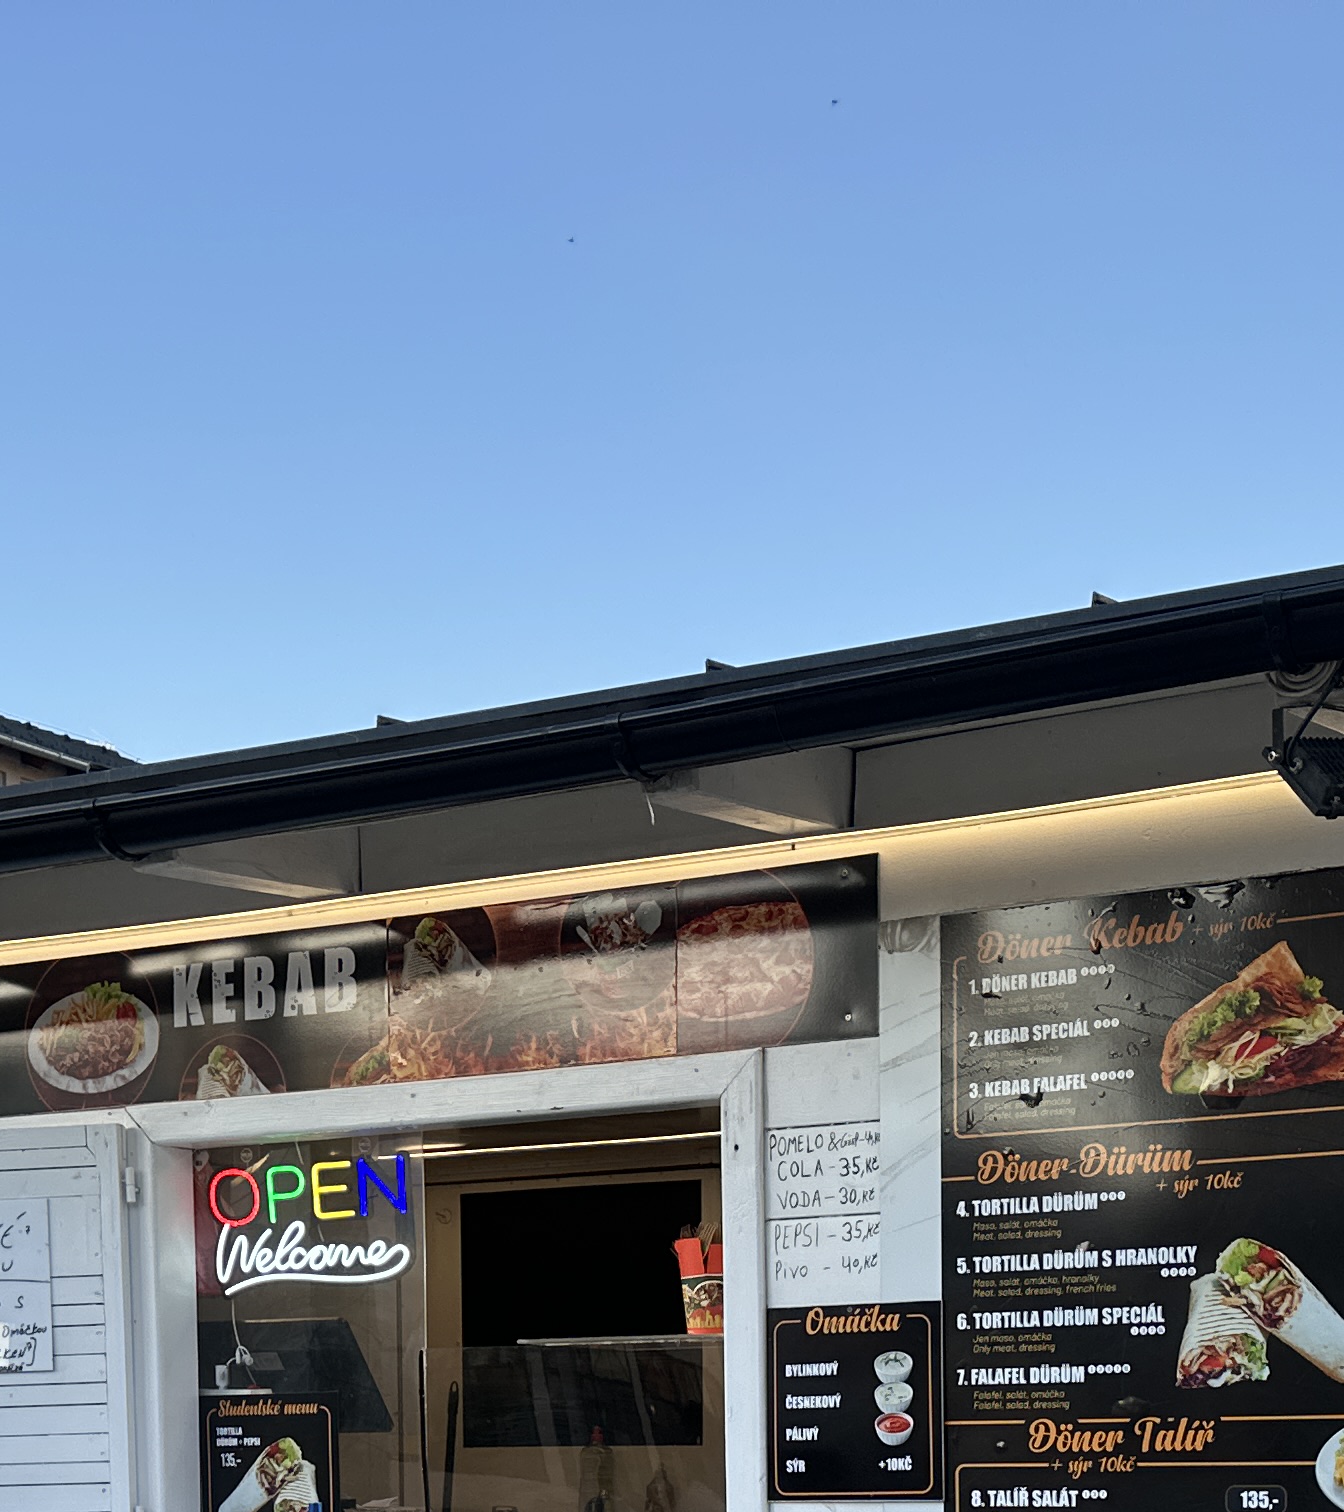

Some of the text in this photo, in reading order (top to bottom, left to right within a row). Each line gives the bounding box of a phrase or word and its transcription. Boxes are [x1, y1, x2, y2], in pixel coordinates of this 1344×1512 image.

[977, 911, 1185, 964] Döner Kebab
[172, 946, 359, 1027] KEBAB
[968, 968, 1078, 995] 1. DÖNER KEBAB
[968, 1018, 1090, 1047] 2. KEBAB SPECIÁL
[968, 1073, 1088, 1099] 3. KEBAB FALAFEL
[777, 1159, 824, 1182] COLA
[977, 1143, 1193, 1185] Döner Dürüm
[209, 1154, 407, 1228] OPEN
[777, 1190, 822, 1210] VODA
[956, 1191, 1098, 1217] 4. TORTILLA DÜRÜM
[774, 1222, 819, 1255] PEPSI
[215, 1220, 410, 1291] Welcome
[956, 1246, 1197, 1274] 5. TORTILLA DÜRÜM S HRANOLKY
[805, 1304, 901, 1335] Omáčka
[956, 1303, 1165, 1330] 6. TORTILLA DÜRÜM SPECIÁL
[785, 1360, 838, 1377] BYLINKOVÝ
[956, 1363, 1085, 1386] 7. FALAFEL DÜRÜM
[217, 1399, 319, 1417] Studentské menu
[785, 1392, 841, 1409] ČESNEKOVÝ
[785, 1425, 819, 1441] PÁLIVÝ
[1028, 1417, 1215, 1453] Döner Talíř
[786, 1458, 806, 1473] SÝR
[971, 1487, 1079, 1508] 8. TALÍŘ SALÁT
[1240, 1490, 1279, 1510] 135,-
